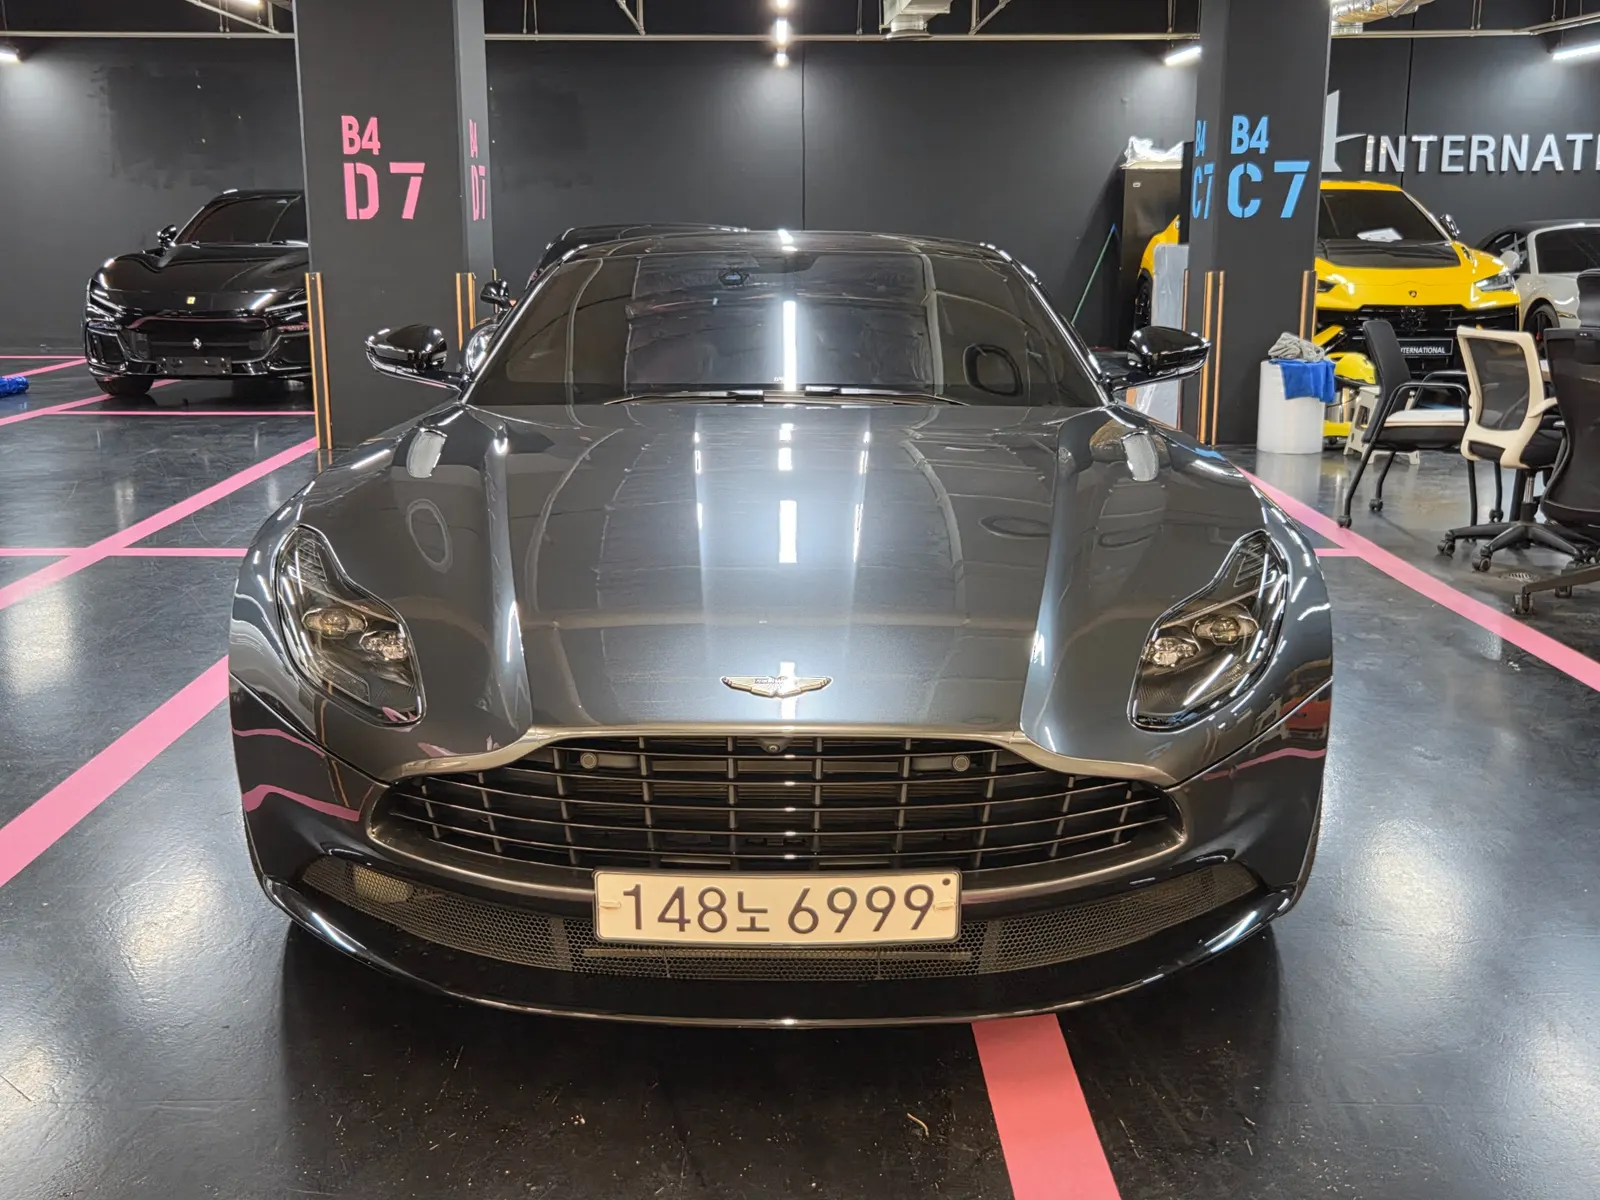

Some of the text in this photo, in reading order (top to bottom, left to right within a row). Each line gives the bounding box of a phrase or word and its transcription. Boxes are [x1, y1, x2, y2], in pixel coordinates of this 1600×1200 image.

[341, 115, 381, 156] B4
[1195, 120, 1207, 157] B4
[1230, 115, 1269, 154] B4
[623, 884, 935, 934] 148노 6999
